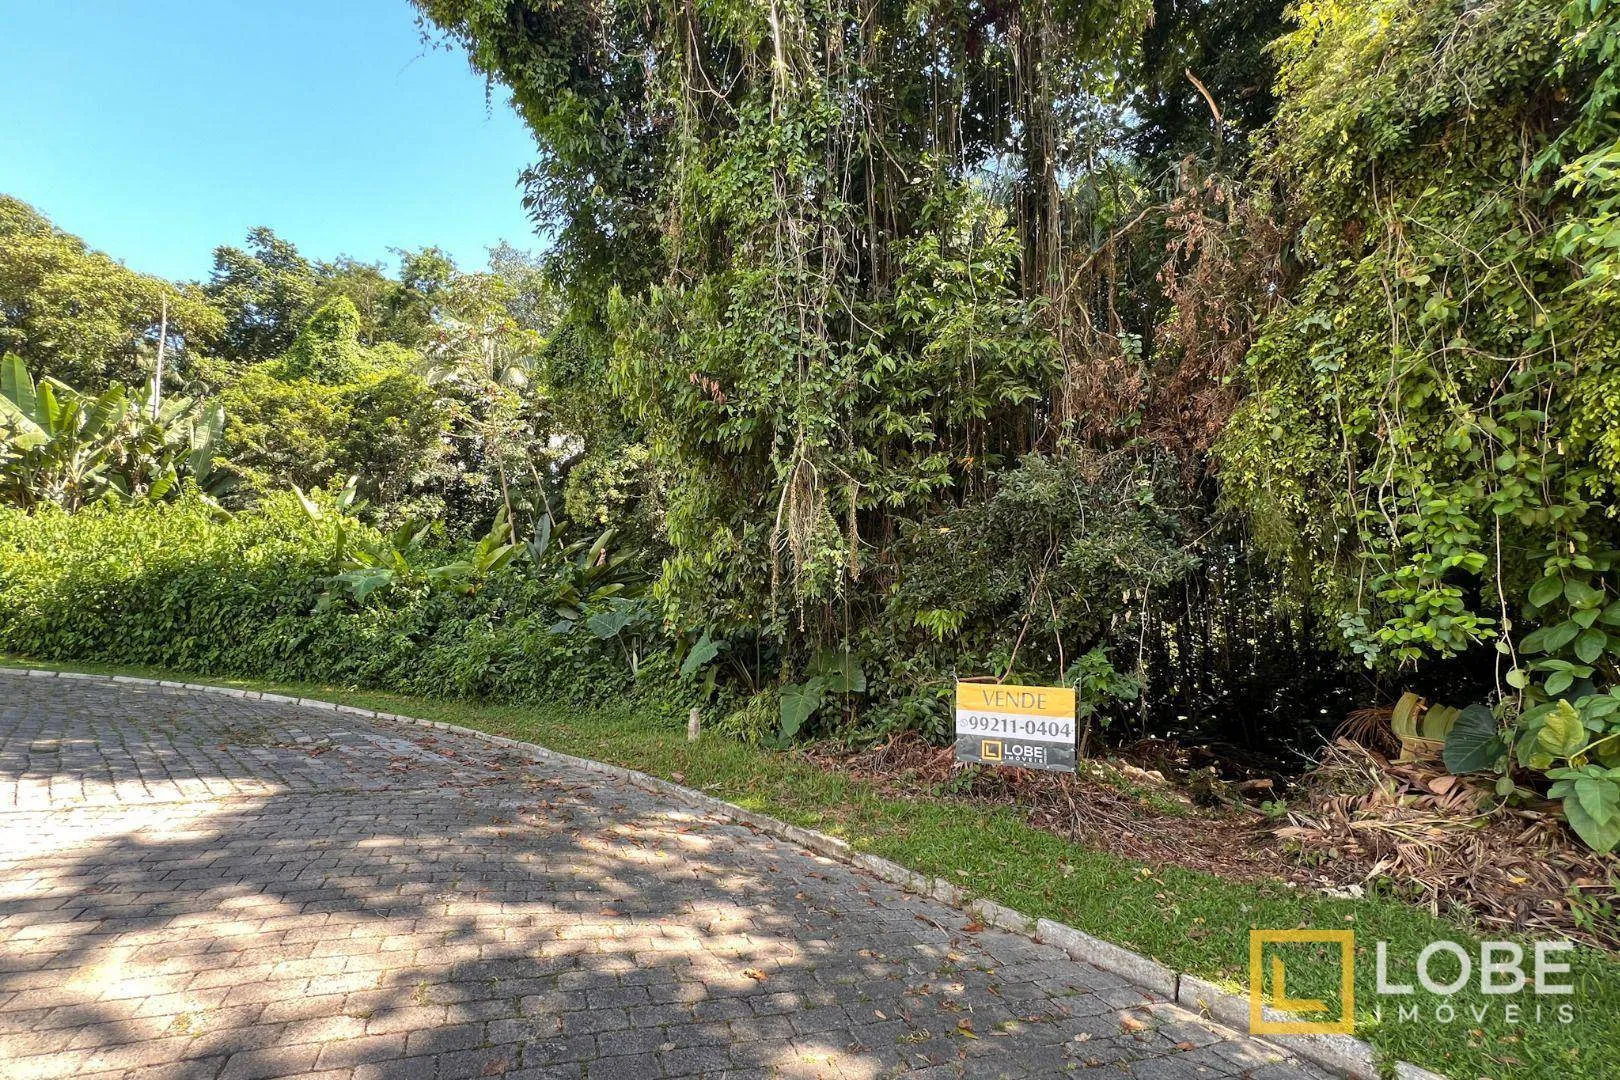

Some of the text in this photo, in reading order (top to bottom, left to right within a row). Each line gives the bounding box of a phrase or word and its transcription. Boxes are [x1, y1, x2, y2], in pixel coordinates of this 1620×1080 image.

[982, 689, 1047, 710] VENDE
[969, 715, 1072, 738] 99211-0404
[1004, 743, 1043, 758] LOBE
